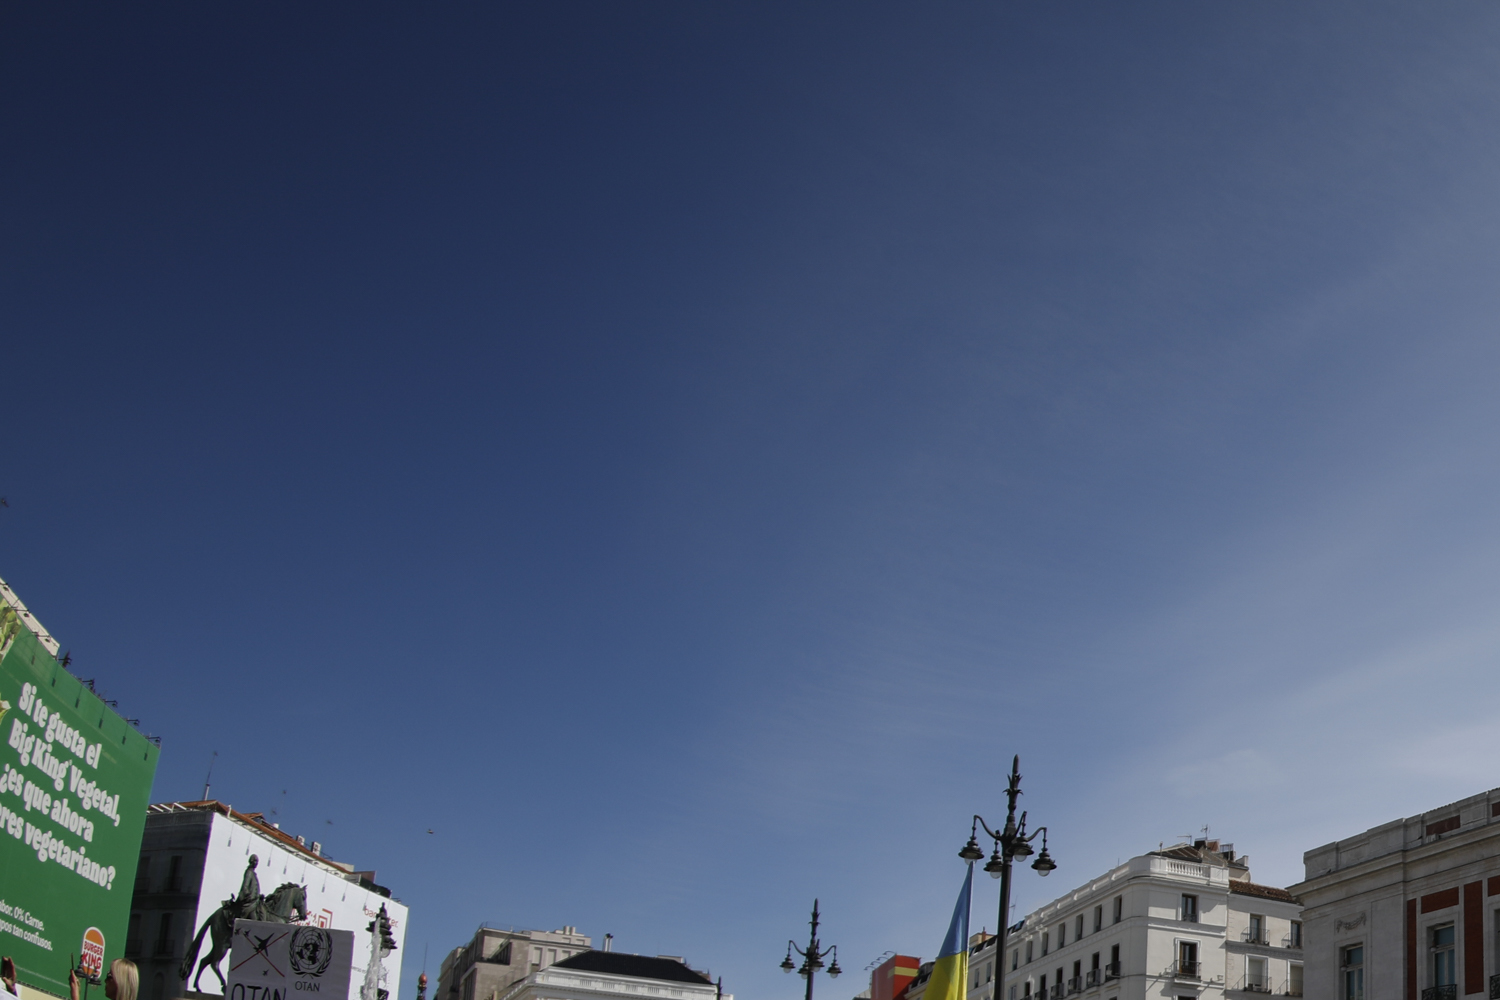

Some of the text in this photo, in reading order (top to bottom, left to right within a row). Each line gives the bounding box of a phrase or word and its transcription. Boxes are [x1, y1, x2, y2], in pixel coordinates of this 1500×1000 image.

[18, 682, 102, 769] Si te gusta el
[8, 718, 121, 827] Big King Vegetal,
[0, 763, 94, 842] ¿es que ahora
[0, 803, 116, 891] res vegetariano?
[14, 906, 25, 922] 0%
[24, 912, 45, 931] Carne.
[12, 924, 24, 938] tan
[23, 930, 53, 951] confusos.
[84, 941, 103, 957] BURGER
[82, 951, 102, 970] KING
[295, 981, 320, 992] OTAN
